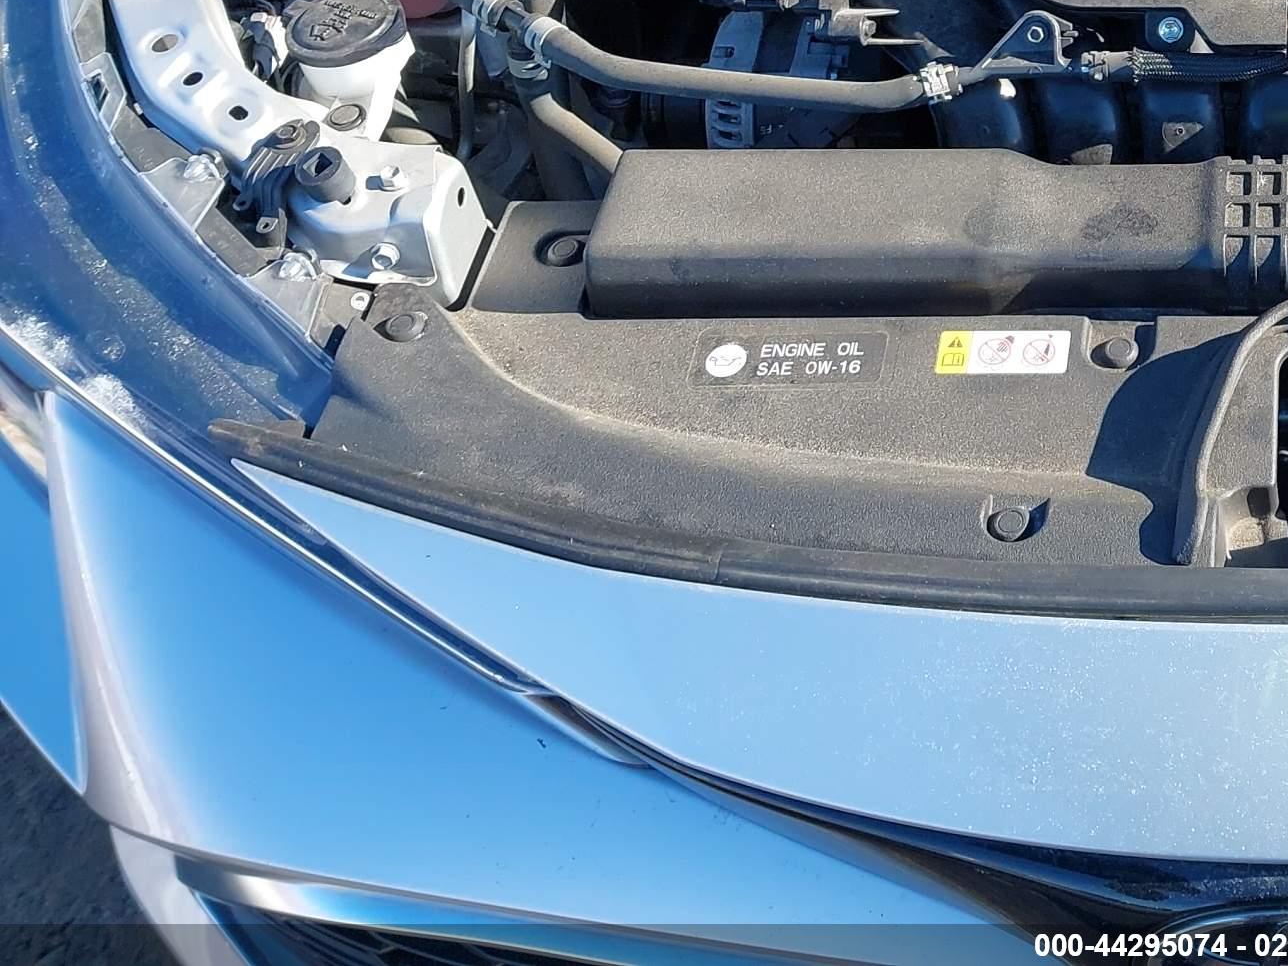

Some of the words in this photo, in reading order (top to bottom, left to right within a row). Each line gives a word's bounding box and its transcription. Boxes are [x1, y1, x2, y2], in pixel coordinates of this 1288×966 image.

[760, 342, 827, 358] ENGINE
[837, 341, 865, 356] OIL
[756, 361, 794, 376] SAE
[805, 359, 862, 375] 0W-16
